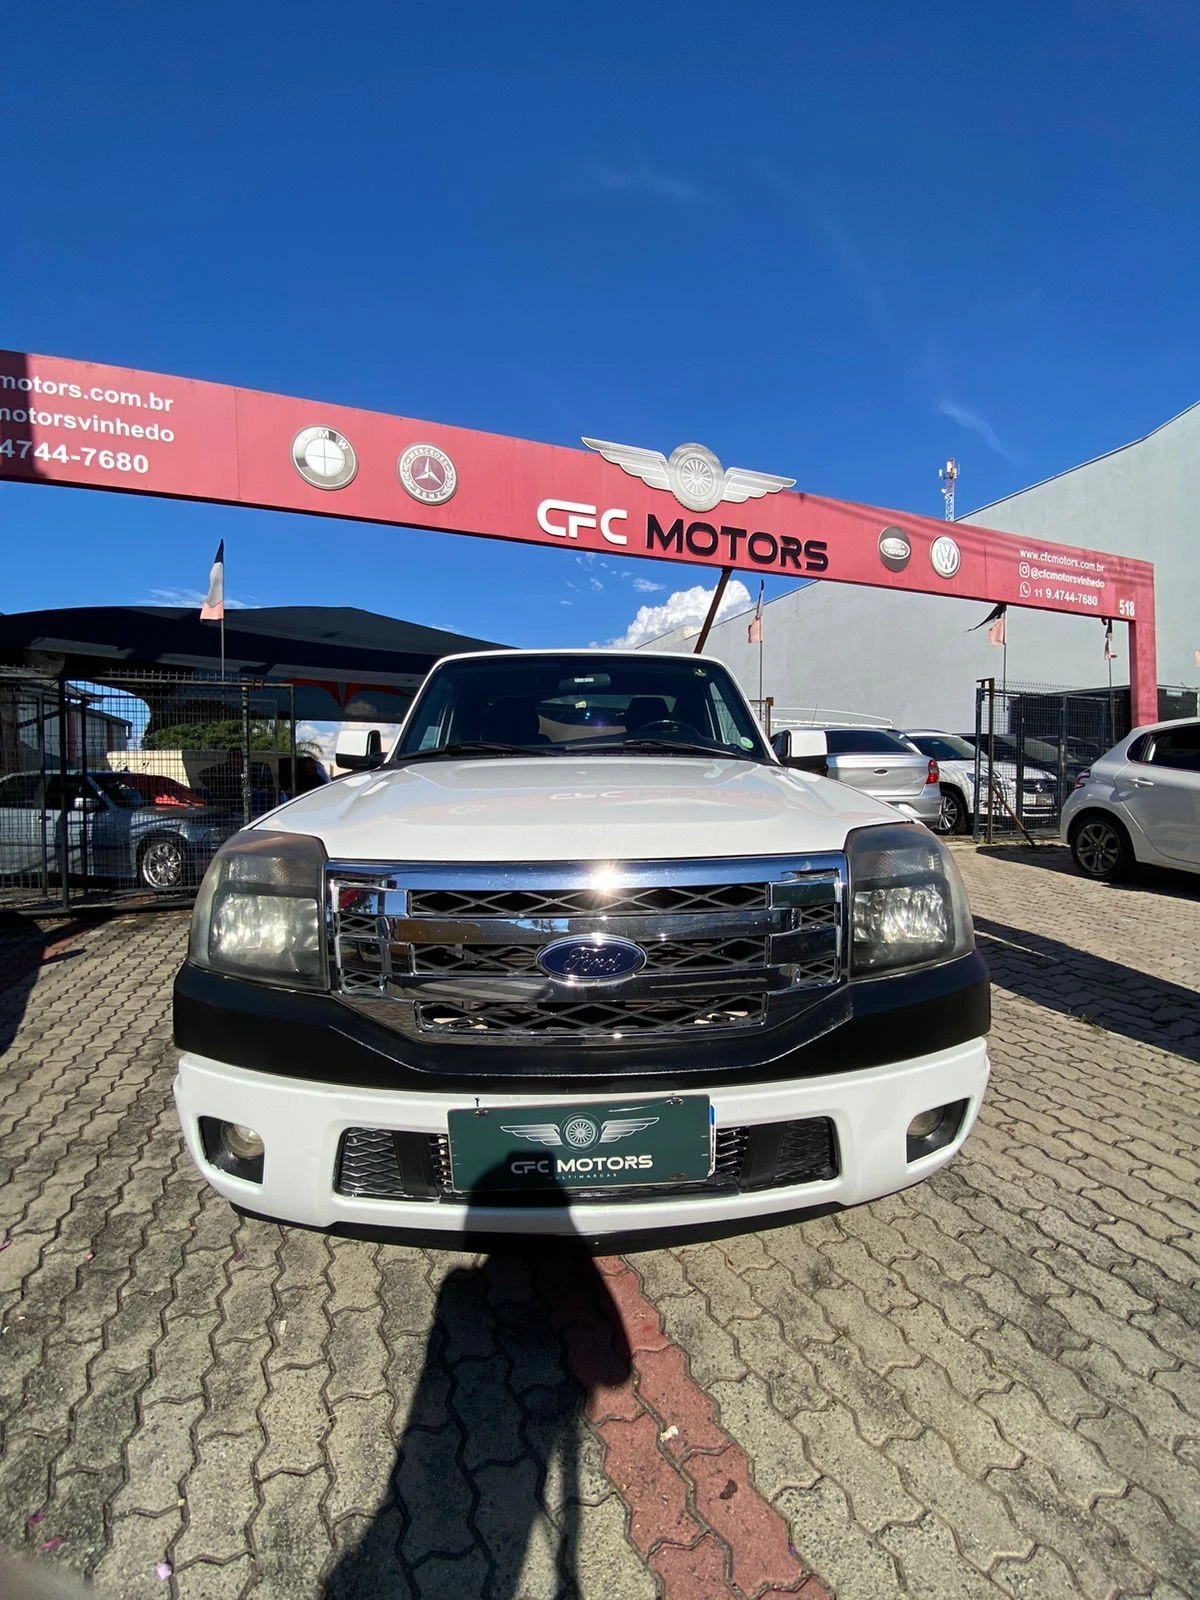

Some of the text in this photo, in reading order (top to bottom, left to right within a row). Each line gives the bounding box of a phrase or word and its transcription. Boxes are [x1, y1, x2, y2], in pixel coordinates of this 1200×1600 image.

[0, 438, 149, 474] 4744-7680
[536, 499, 829, 572] CFC MOTORS
[1019, 549, 1105, 573] www.cfcmotors.com.br
[1030, 567, 1105, 589] @cfcmotorsvinhedo
[1034, 588, 1098, 606] 11 9.4744-7680
[1119, 599, 1135, 617] 518
[563, 946, 621, 972] Ford
[510, 1154, 653, 1174] CFC MOTORS
